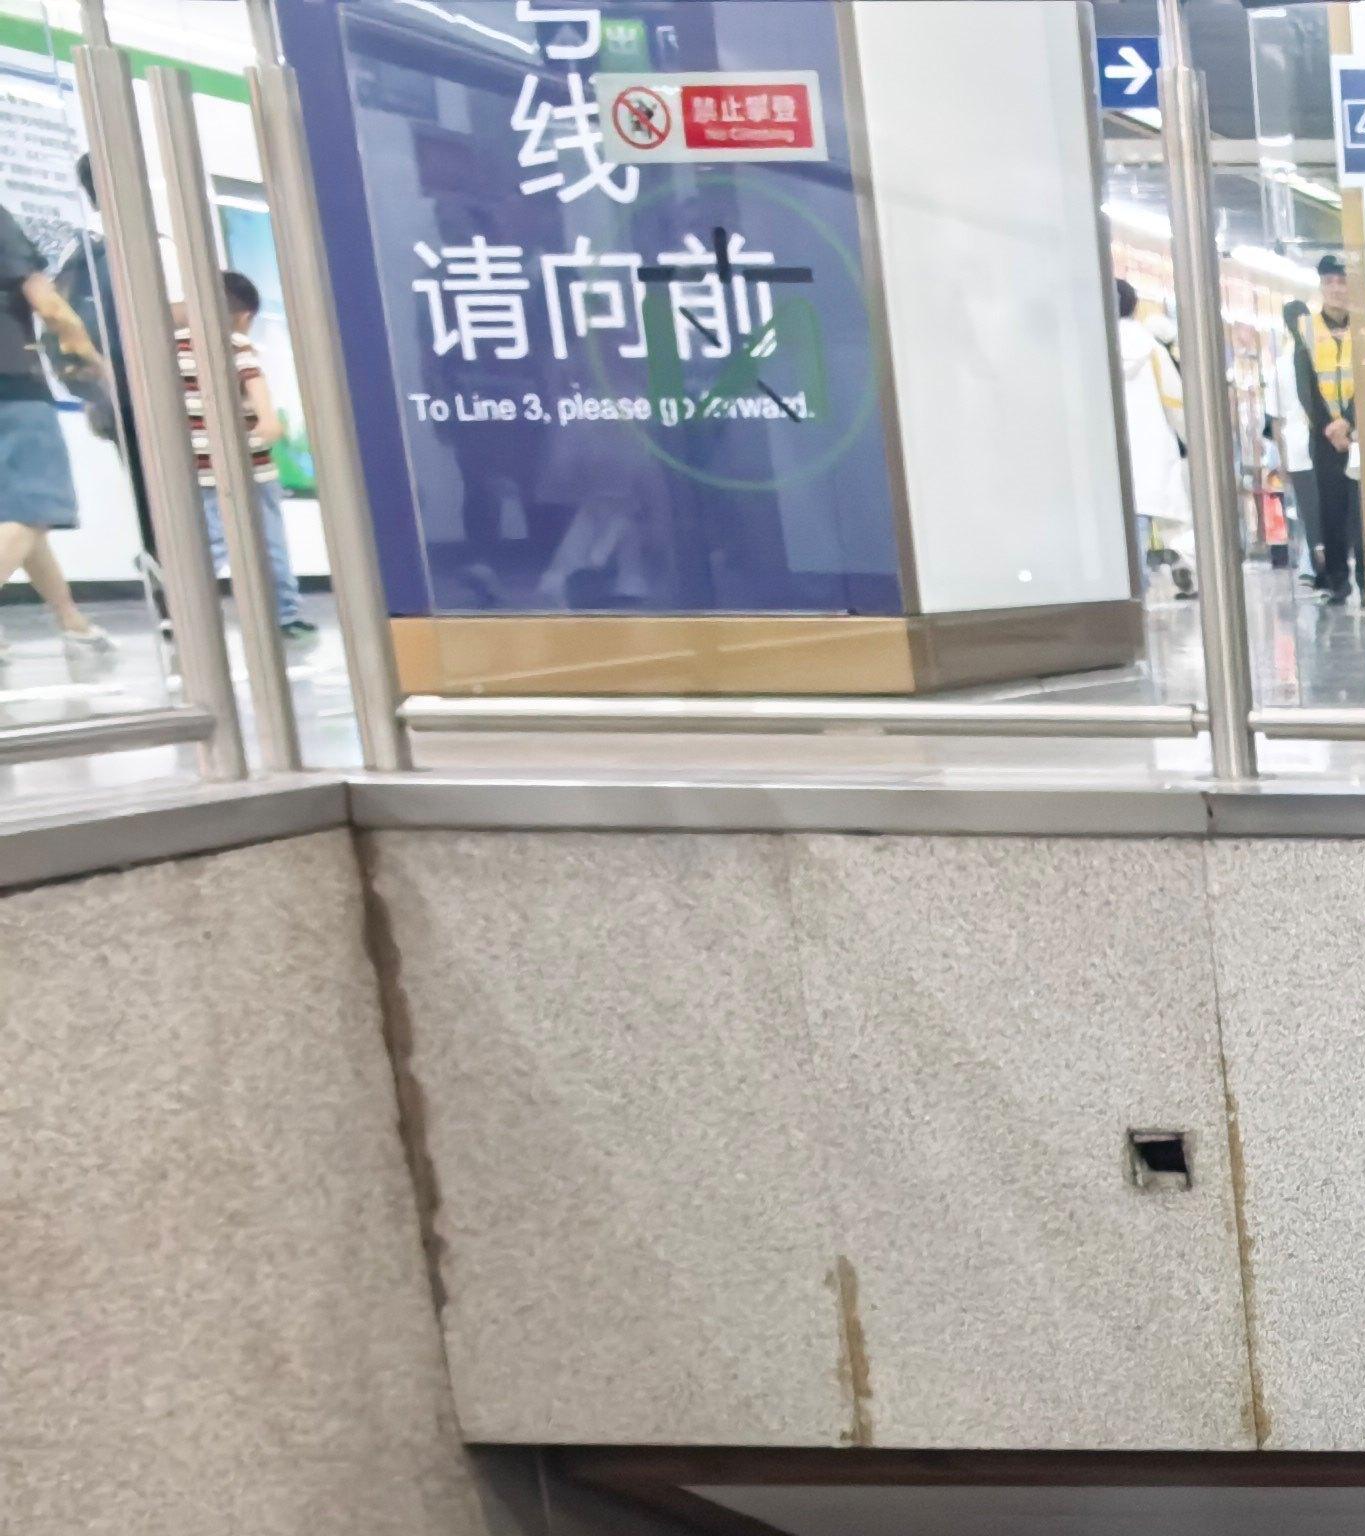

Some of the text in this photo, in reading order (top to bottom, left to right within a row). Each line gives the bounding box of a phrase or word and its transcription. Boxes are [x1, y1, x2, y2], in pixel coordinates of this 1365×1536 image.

[411, 234, 778, 361] 请向前
[411, 394, 449, 422] To
[455, 393, 517, 422] Line
[523, 394, 551, 424] 3,
[557, 390, 652, 427] please
[703, 391, 816, 424] ward.
